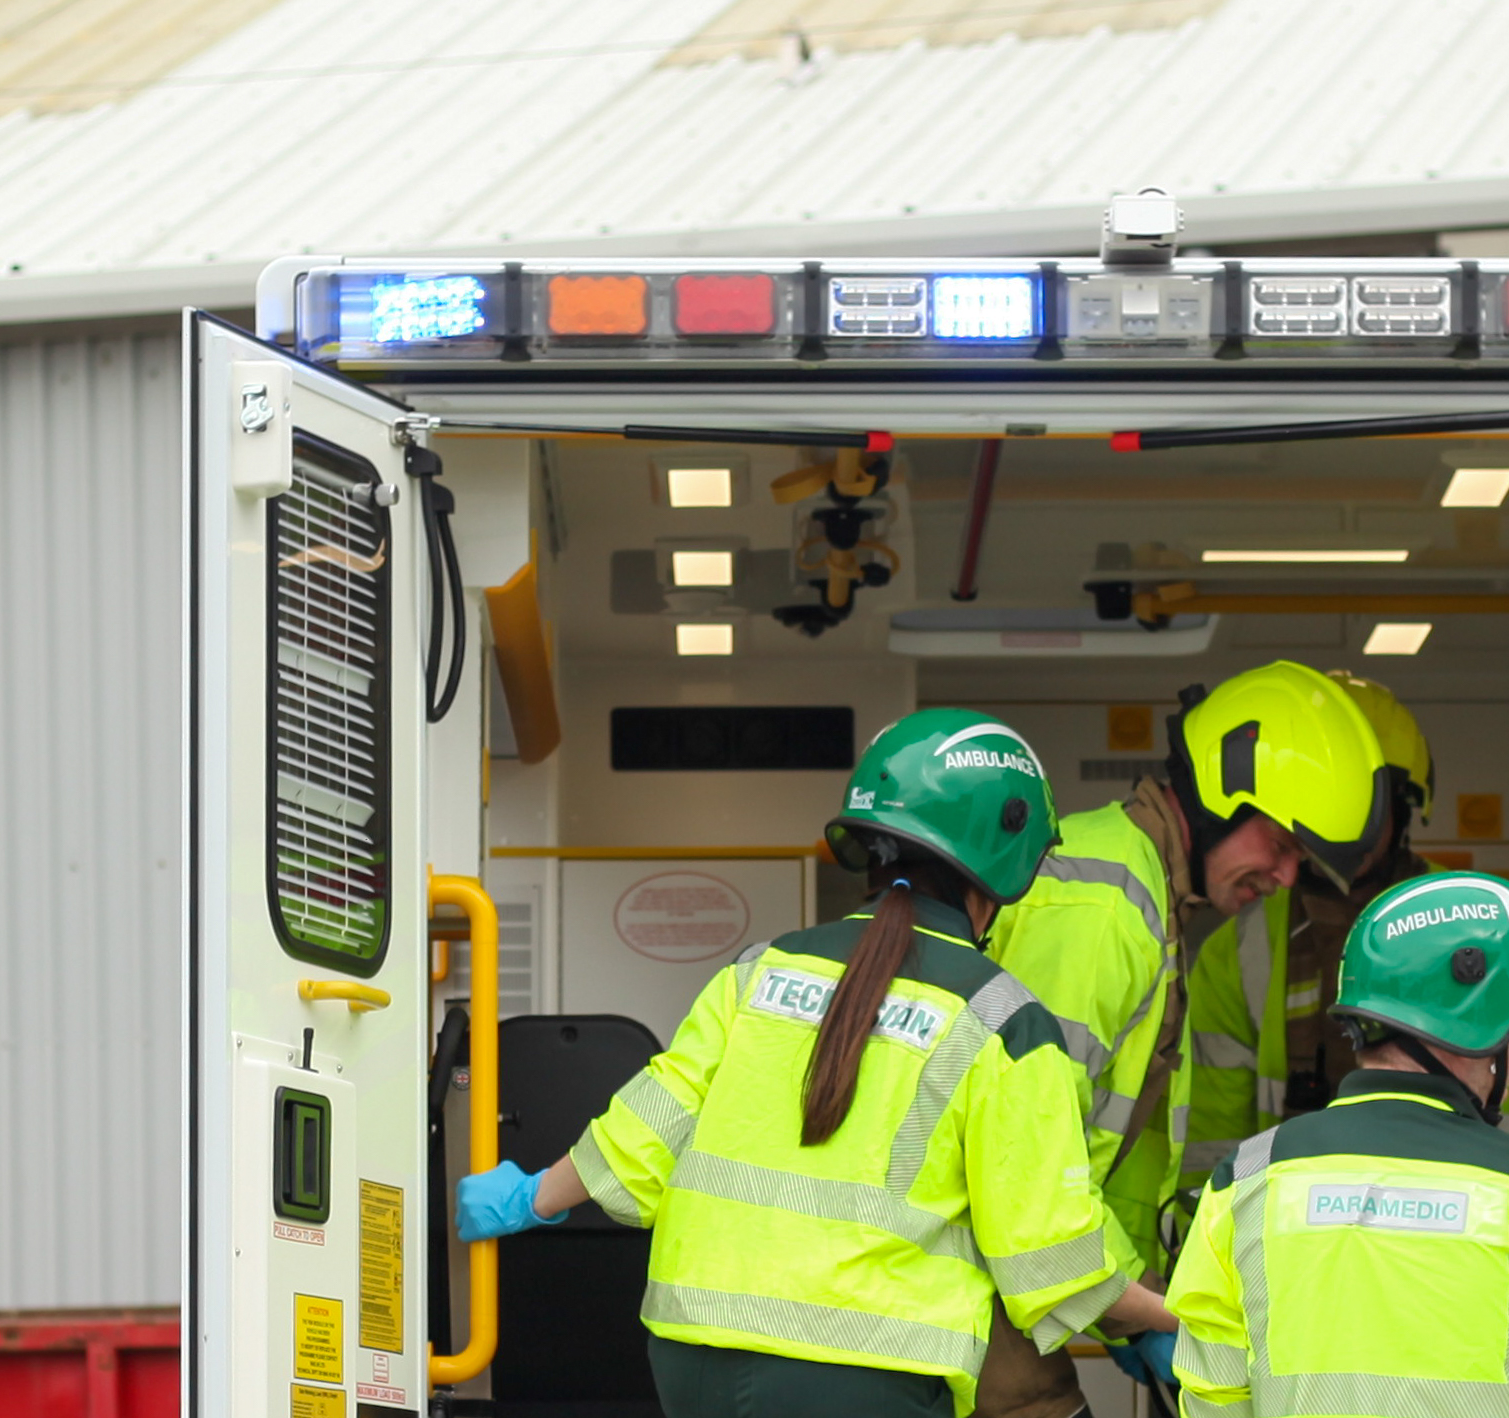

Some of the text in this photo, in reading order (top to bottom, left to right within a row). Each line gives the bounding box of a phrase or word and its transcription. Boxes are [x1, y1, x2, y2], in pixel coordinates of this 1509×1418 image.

[944, 749, 1037, 778] AMBULANCE
[1386, 903, 1501, 940] AMBULANCE
[764, 974, 937, 1041] TECIAN
[1316, 1195, 1459, 1222] PARAMEDIC
